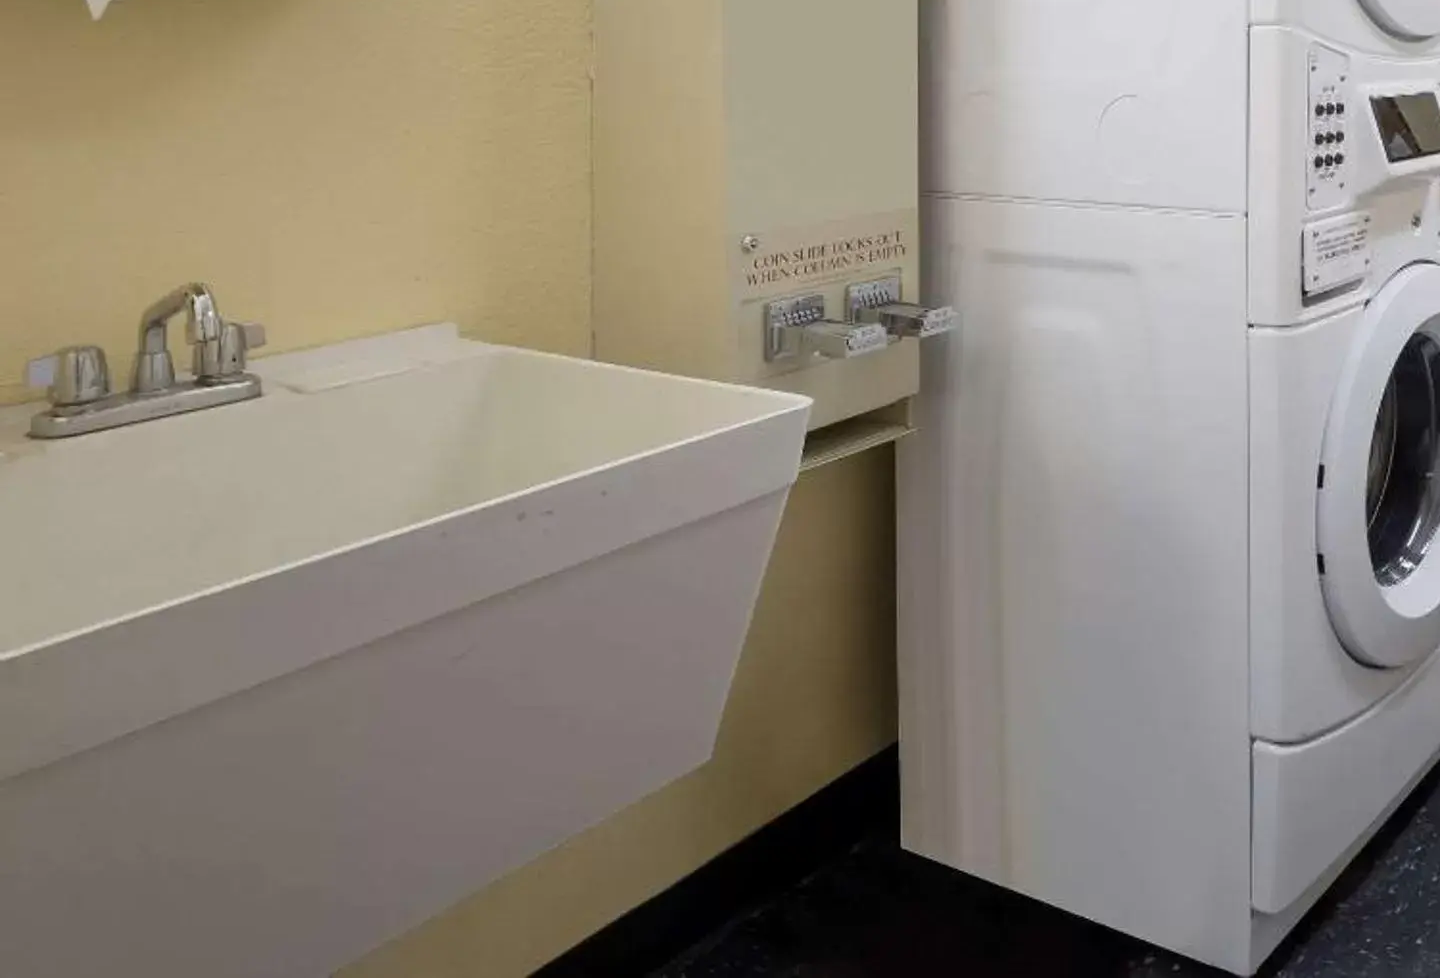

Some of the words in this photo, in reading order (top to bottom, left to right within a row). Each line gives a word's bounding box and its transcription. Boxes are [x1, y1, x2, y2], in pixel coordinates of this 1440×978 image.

[746, 268, 789, 286] WHEN
[792, 257, 851, 277] COLUMN
[855, 252, 865, 263] IS
[868, 243, 907, 263] EMPTY
[753, 252, 789, 270] COIN
[793, 244, 825, 264] SLIDE
[832, 236, 873, 254] LOCKS
